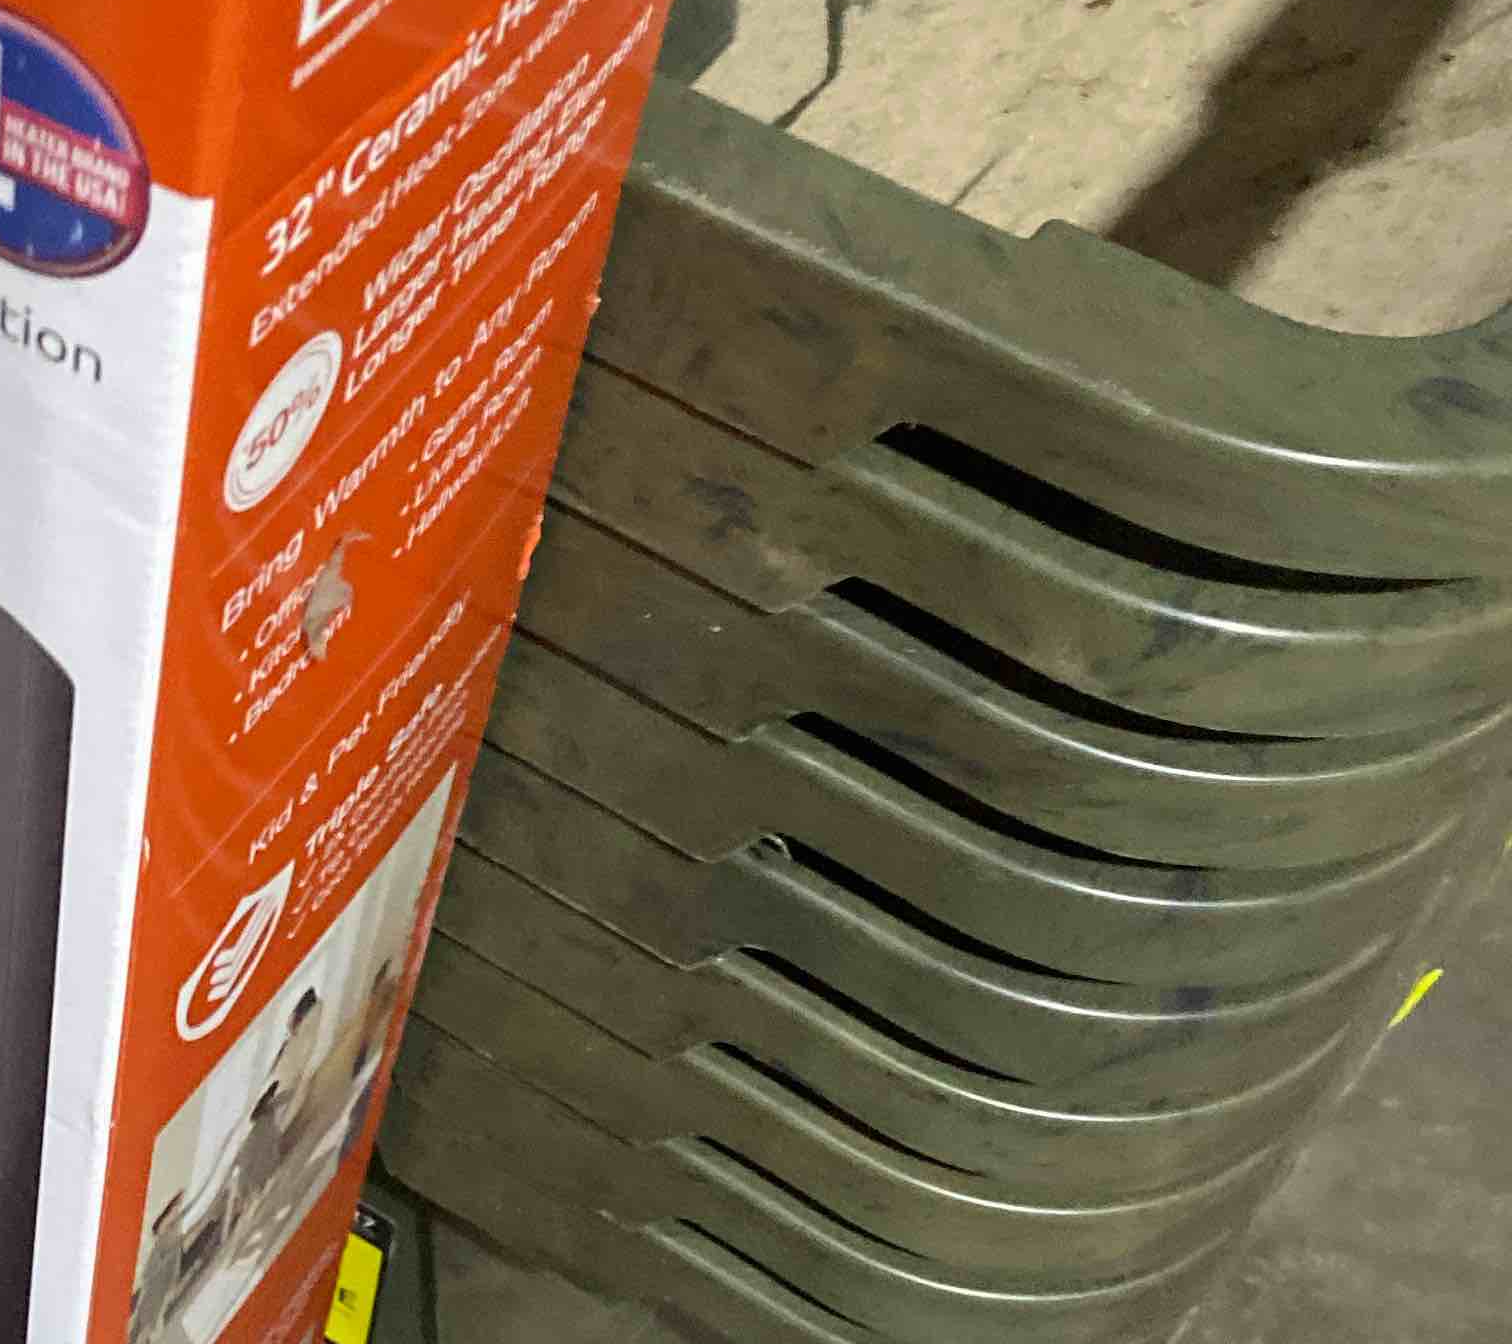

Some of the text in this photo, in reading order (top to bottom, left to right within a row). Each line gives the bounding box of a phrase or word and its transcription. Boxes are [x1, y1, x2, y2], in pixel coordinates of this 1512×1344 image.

[248, 189, 389, 348] Extended
[389, 122, 458, 210] Heat
[455, 56, 525, 141] Zone
[261, 169, 335, 277] 32"
[341, 23, 494, 196] Ceramic
[342, 97, 607, 404] Longer Timer Range
[353, 2, 654, 358] Larger Heating Element
[362, 52, 591, 311] Wider Oscillation
[220, 189, 599, 633] Bring Warmth to Any Room
[412, 346, 545, 508] Living Room
[420, 297, 553, 463] Game Room
[242, 603, 354, 733] Bedrm
[248, 795, 295, 865] Kid
[327, 710, 371, 775] Pet
[306, 764, 381, 856] Triple
